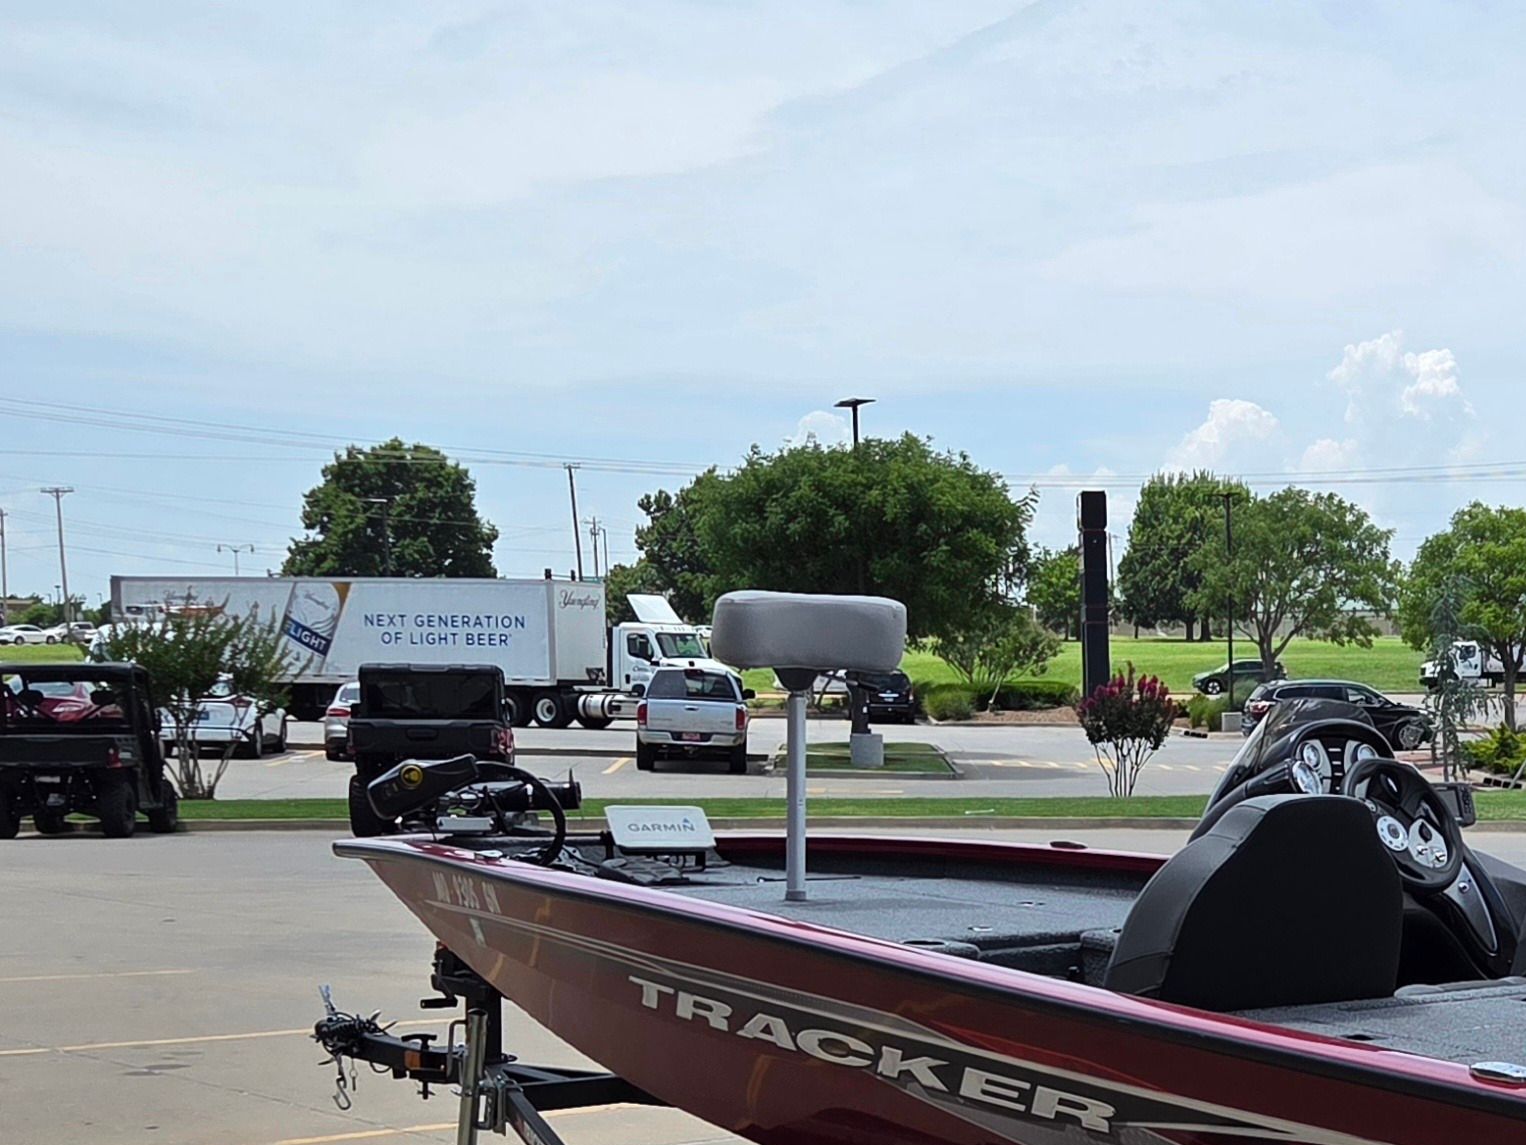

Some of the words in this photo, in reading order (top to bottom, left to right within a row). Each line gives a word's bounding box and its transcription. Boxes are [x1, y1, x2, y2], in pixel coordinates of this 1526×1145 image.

[364, 614, 407, 628] NEXT
[414, 614, 526, 629] GENERATION
[381, 631, 403, 645] OF
[410, 632, 459, 646] LIGHT
[466, 632, 509, 647] BEER
[627, 822, 696, 832] GARMIN
[628, 975, 1117, 1134] TRACKER
